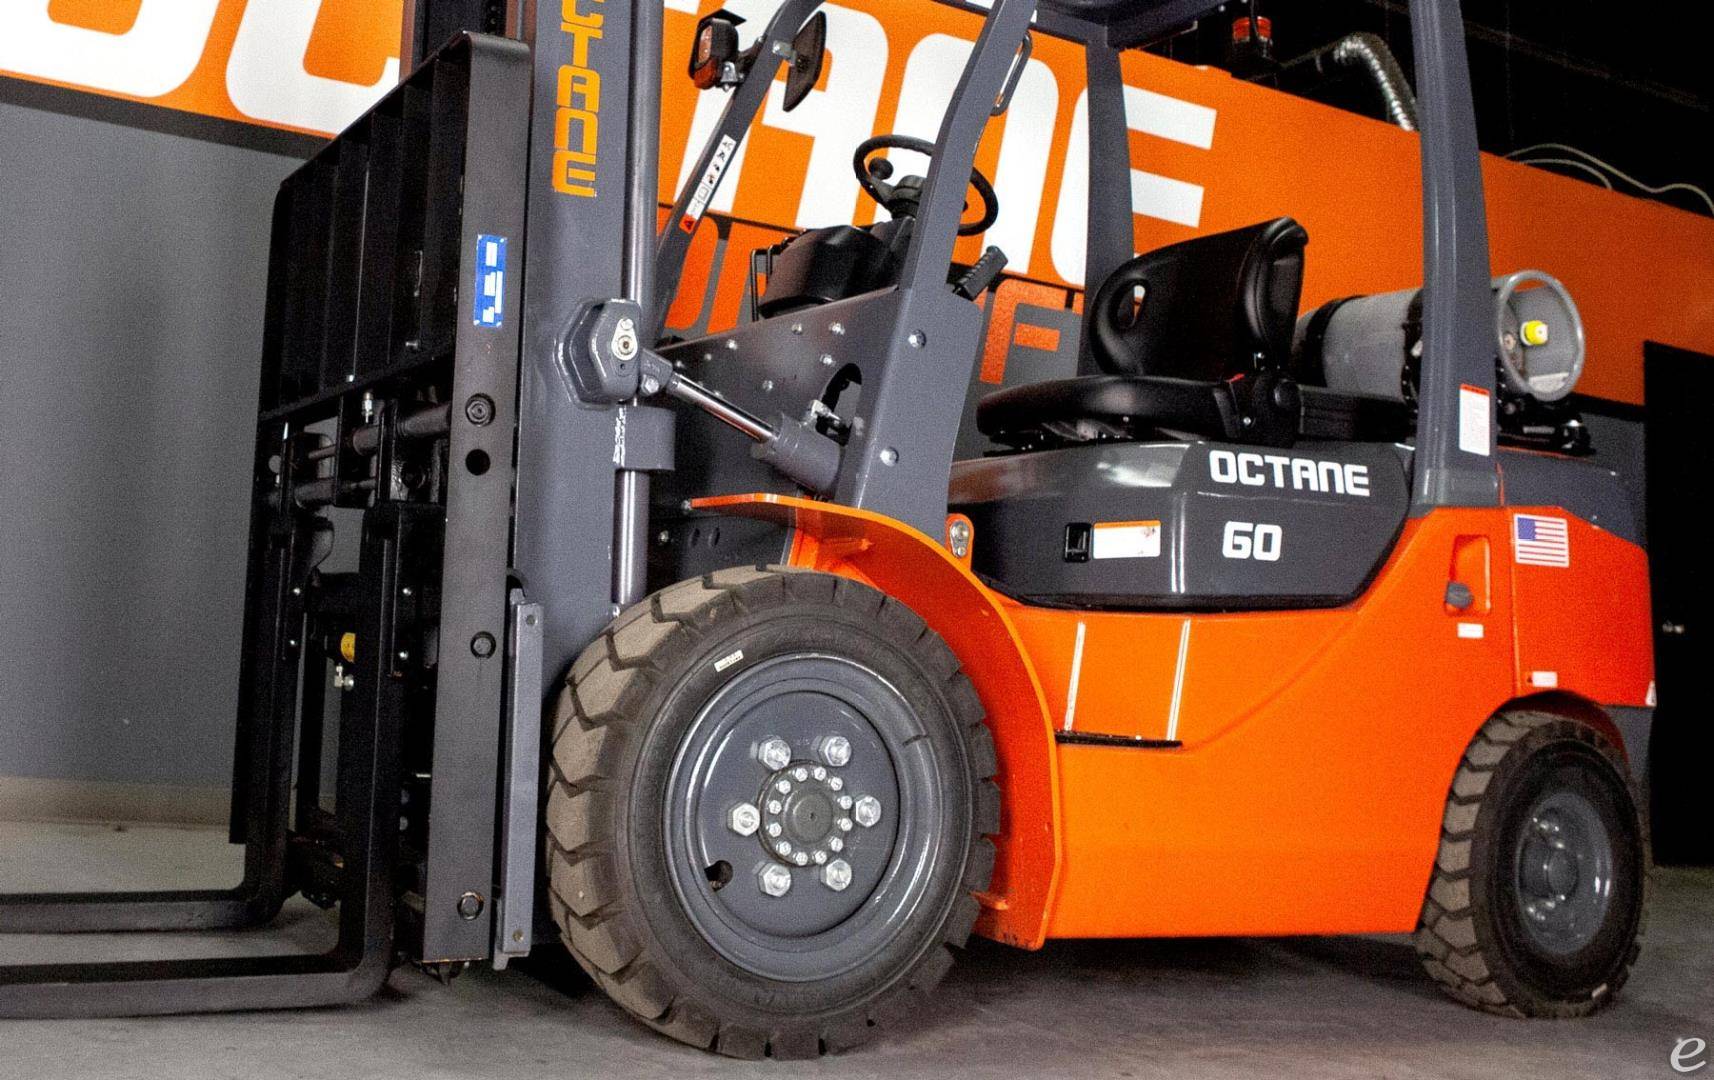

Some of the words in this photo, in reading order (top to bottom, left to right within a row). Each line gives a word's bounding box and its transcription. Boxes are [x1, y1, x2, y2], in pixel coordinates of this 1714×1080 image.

[0, 0, 1217, 290] ANE
[1209, 450, 1370, 496] OCTANE
[1222, 521, 1282, 561] 60
